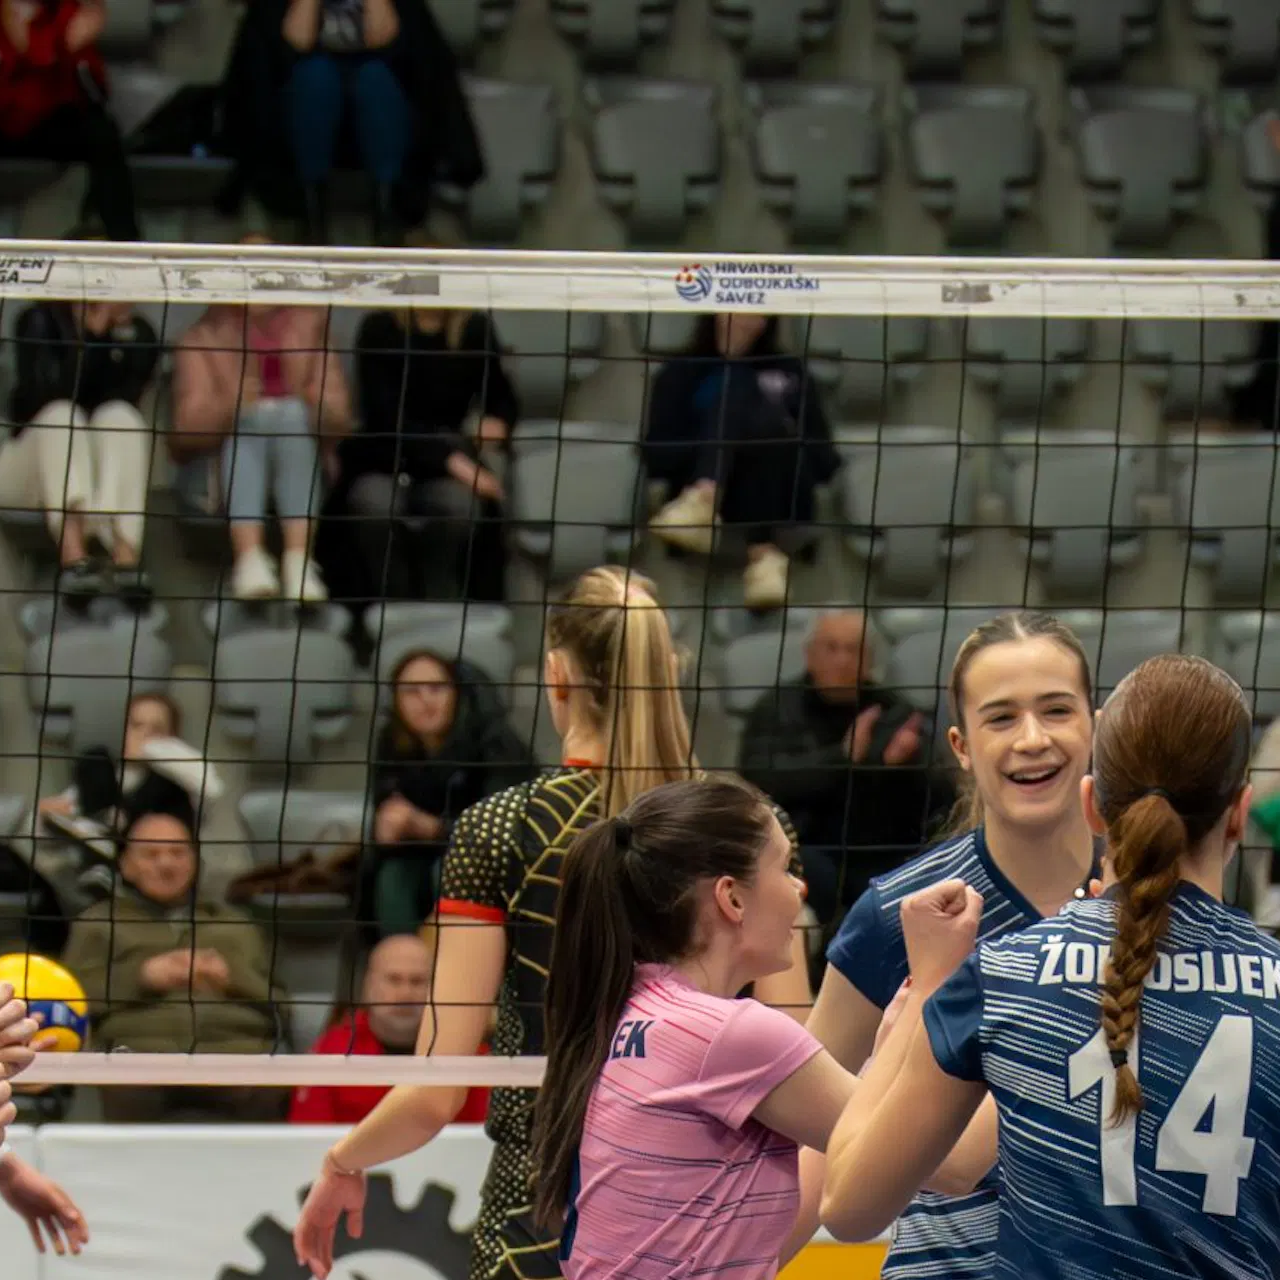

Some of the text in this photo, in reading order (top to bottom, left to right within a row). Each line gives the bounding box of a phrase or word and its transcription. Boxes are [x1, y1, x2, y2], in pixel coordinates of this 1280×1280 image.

[715, 261, 794, 275] HRVATSKI
[718, 274, 820, 290] ODBOJKAŠKI
[715, 290, 766, 305] SAVEZ
[1068, 1014, 1256, 1217] 14
